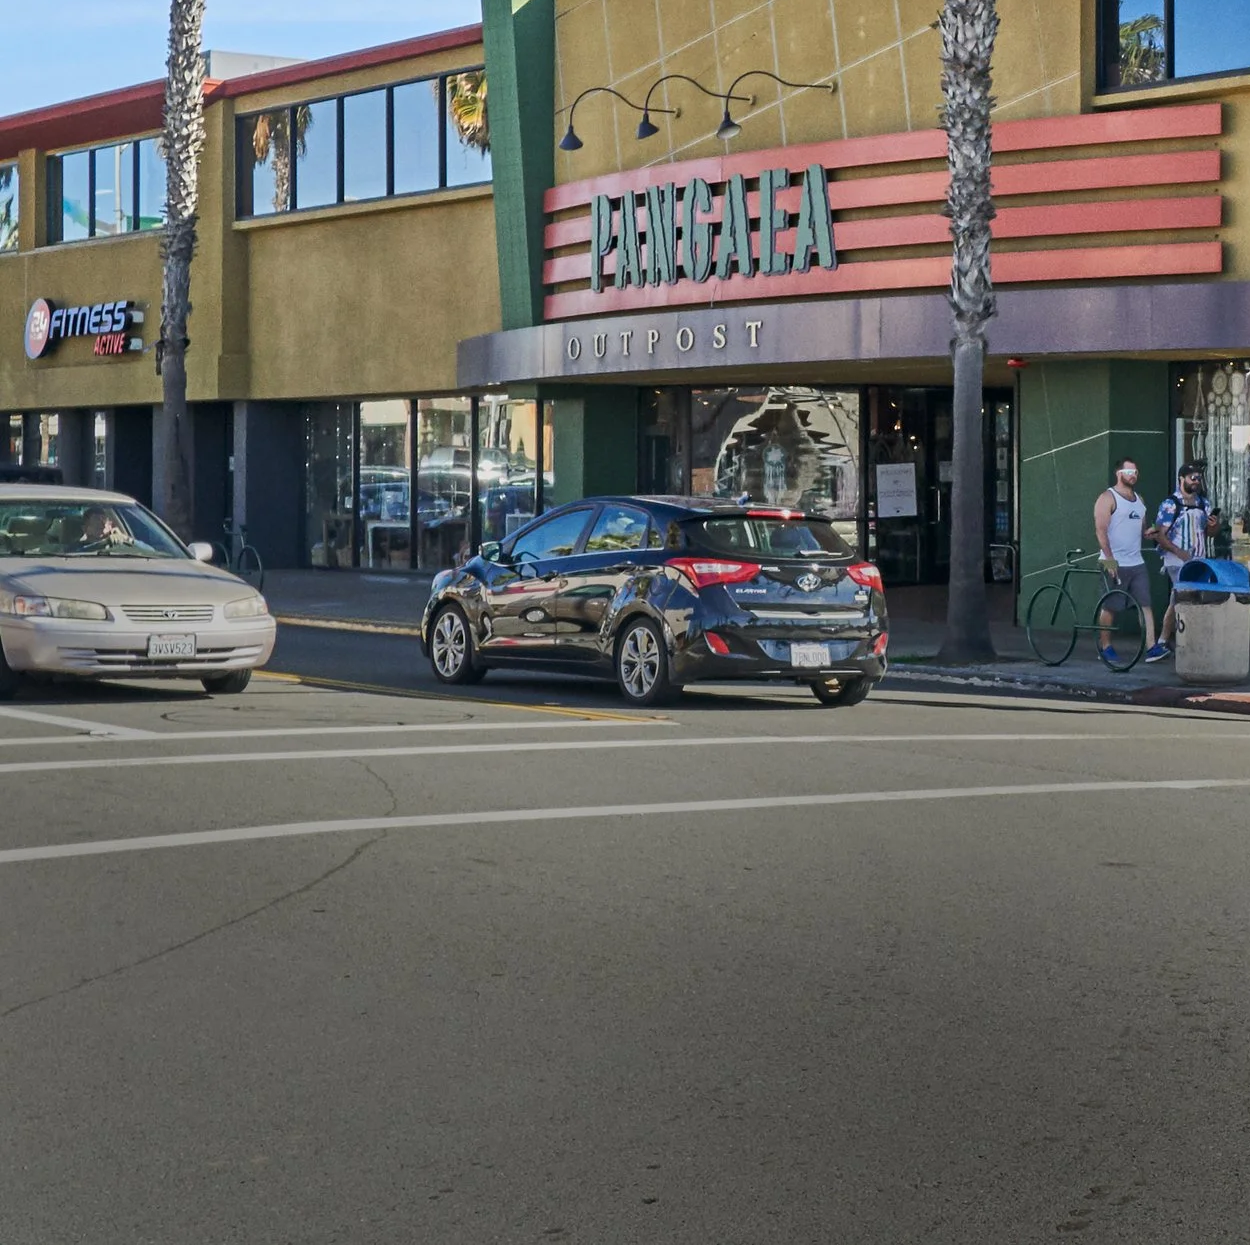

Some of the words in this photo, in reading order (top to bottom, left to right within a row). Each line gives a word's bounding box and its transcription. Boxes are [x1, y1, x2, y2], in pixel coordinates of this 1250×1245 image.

[590, 163, 838, 293] PANGAEA
[31, 311, 47, 333] 24
[49, 300, 127, 339] FITNESS
[93, 333, 126, 356] ACTIVE
[567, 320, 763, 360] OUTPOST
[151, 642, 193, 655] 3VSV523
